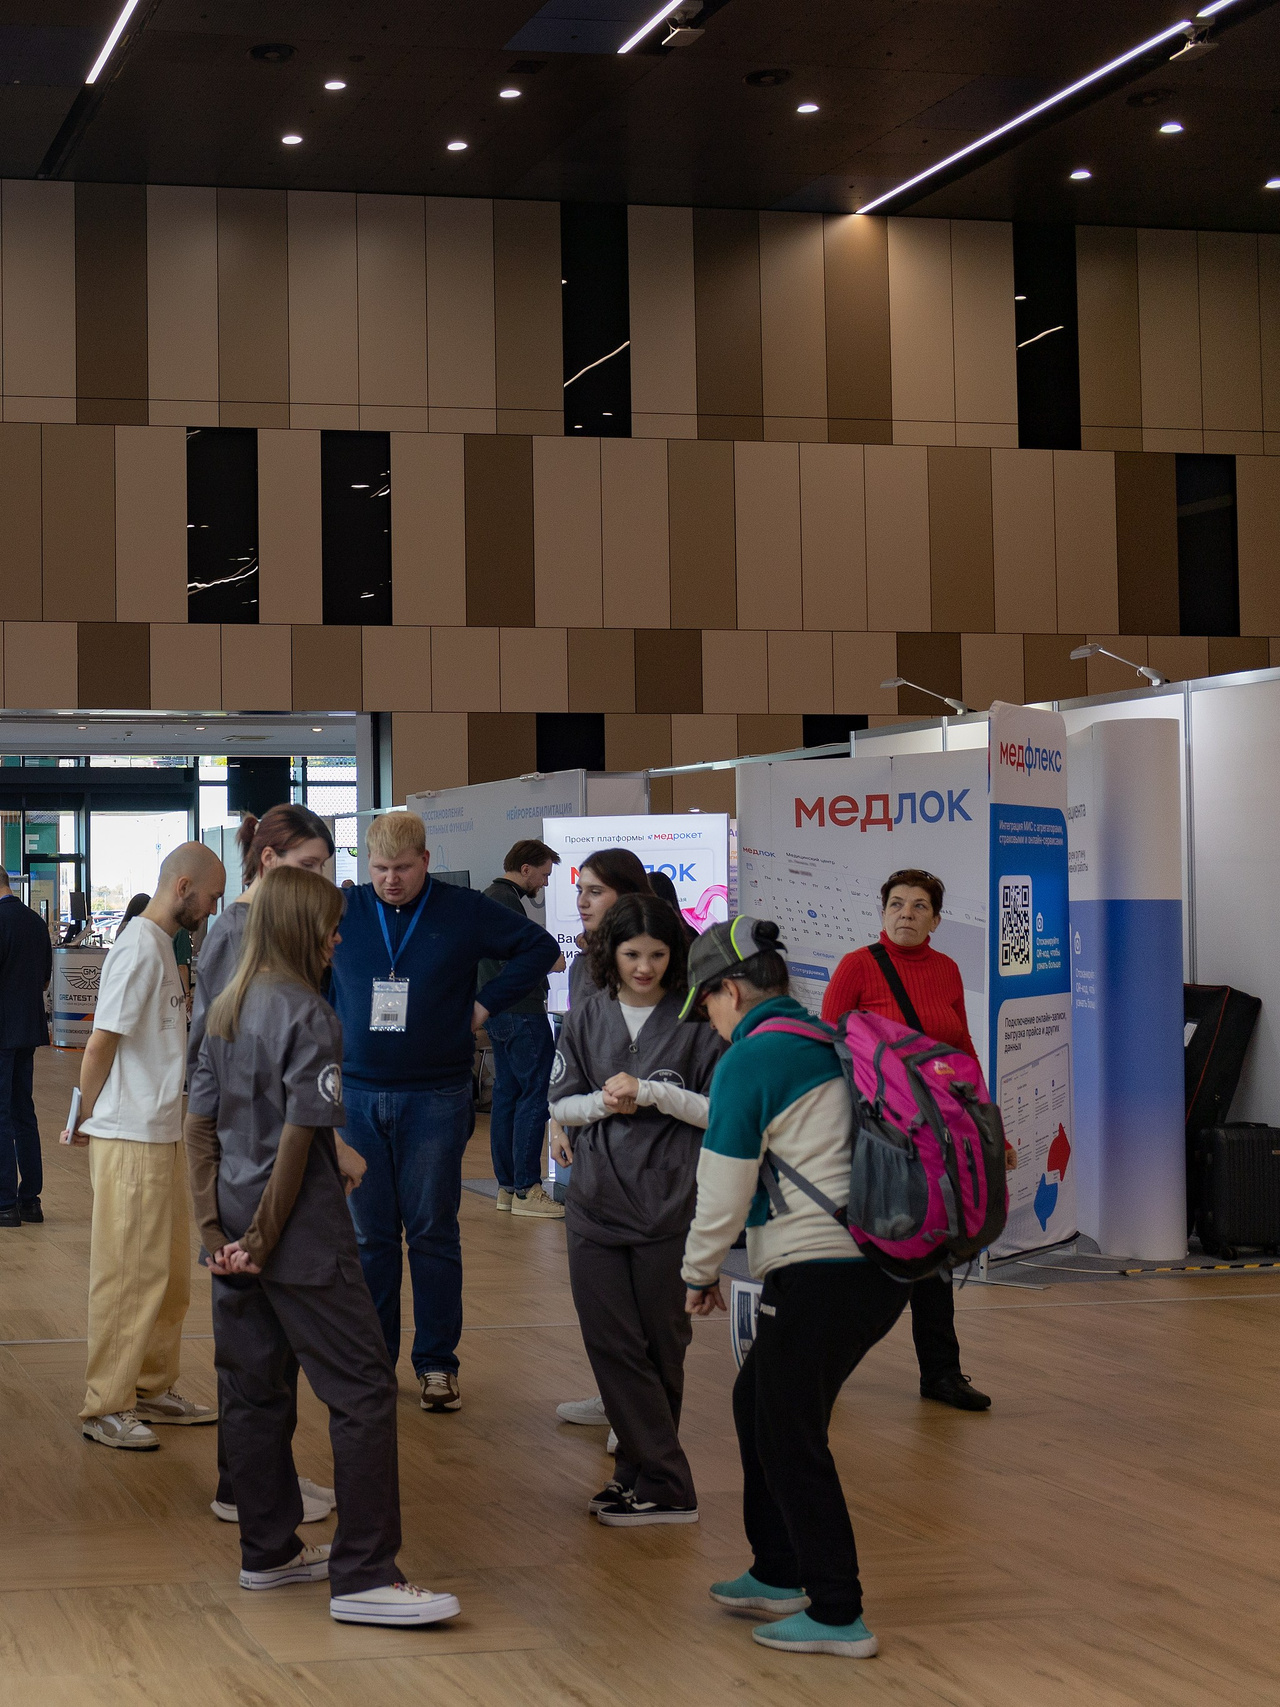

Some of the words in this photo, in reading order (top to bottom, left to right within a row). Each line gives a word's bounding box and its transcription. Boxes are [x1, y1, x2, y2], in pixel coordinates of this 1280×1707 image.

[506, 802, 573, 821] НЕЙРОРЕАБИЛИТАЦИЯ
[565, 835, 595, 844] Проект
[597, 834, 645, 844] платформы
[654, 831, 702, 841] медрокет
[83, 968, 96, 976] GM
[59, 994, 92, 1002] GREATEST
[1004, 1016, 1035, 1028] Подключение
